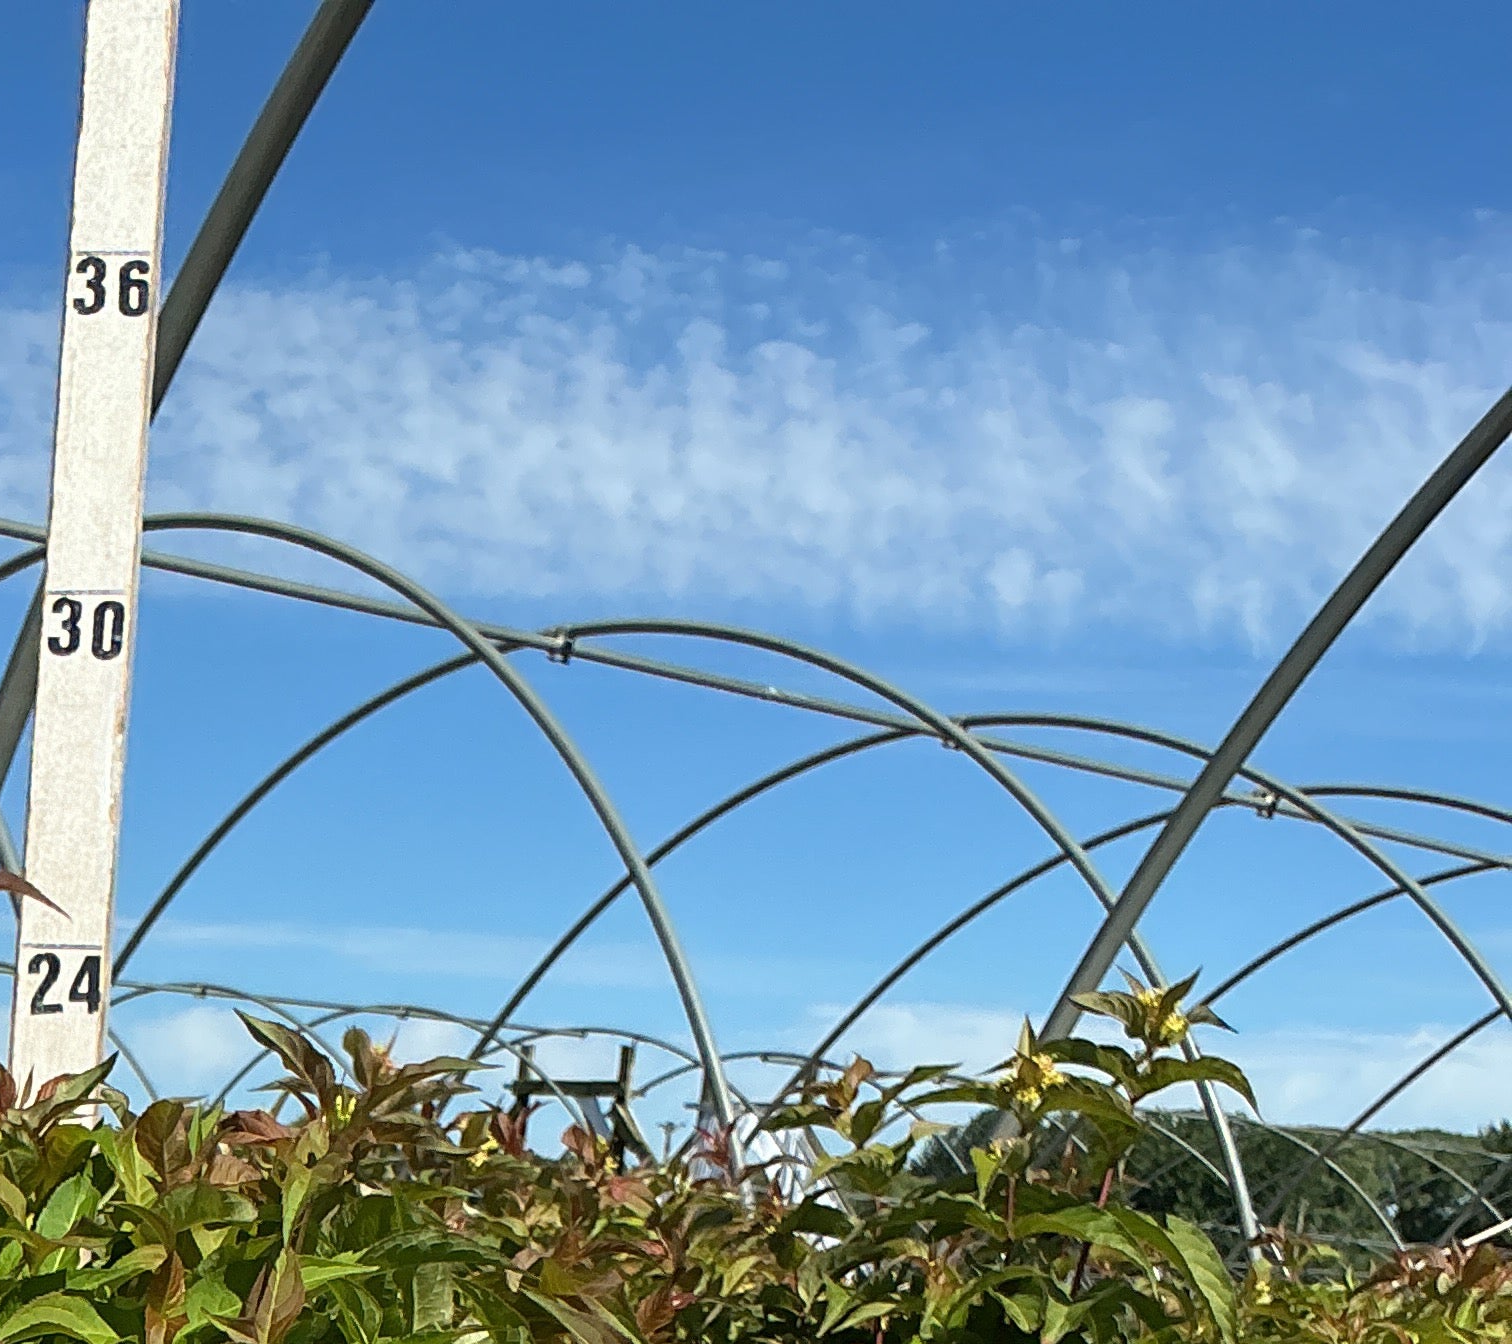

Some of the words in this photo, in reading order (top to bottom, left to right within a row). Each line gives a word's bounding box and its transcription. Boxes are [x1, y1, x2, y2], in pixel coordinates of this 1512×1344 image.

[72, 255, 151, 318] 36
[46, 596, 125, 662] 30
[26, 951, 102, 1017] 24
